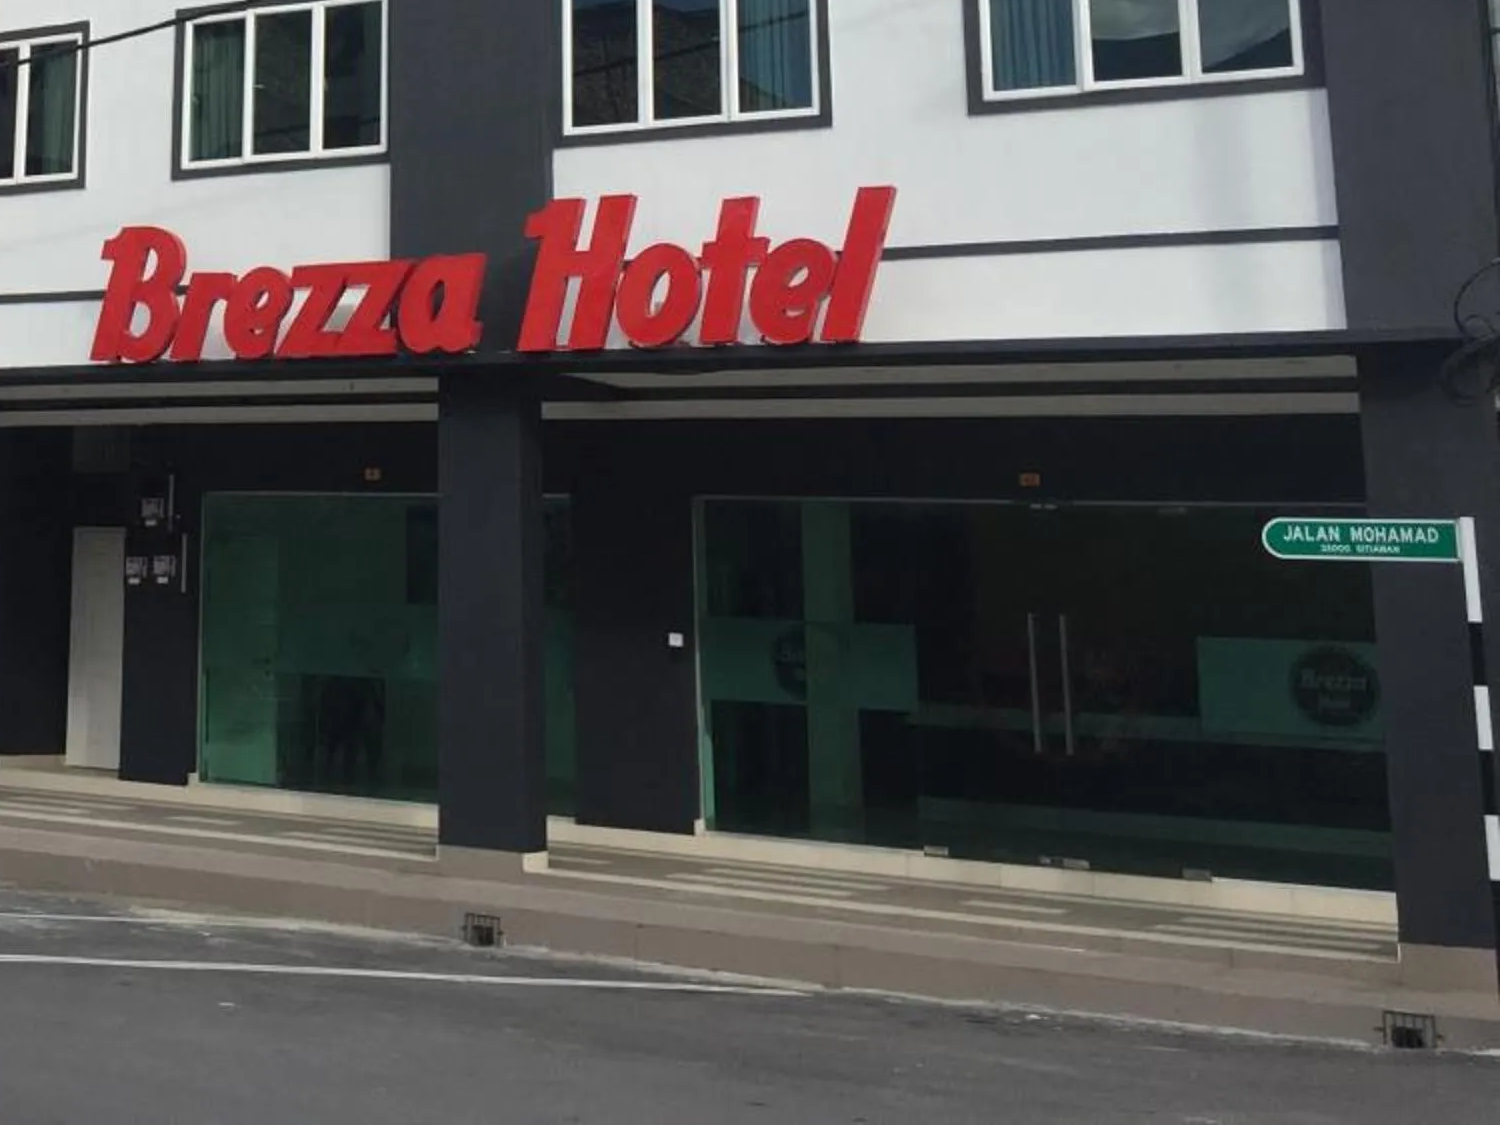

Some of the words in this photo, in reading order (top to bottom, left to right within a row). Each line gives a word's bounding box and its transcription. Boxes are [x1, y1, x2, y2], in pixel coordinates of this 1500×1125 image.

[89, 225, 488, 364] Brezza
[516, 185, 897, 354] Hotel
[1283, 525, 1341, 542] JALAN
[1349, 526, 1439, 544] MOHAMAD
